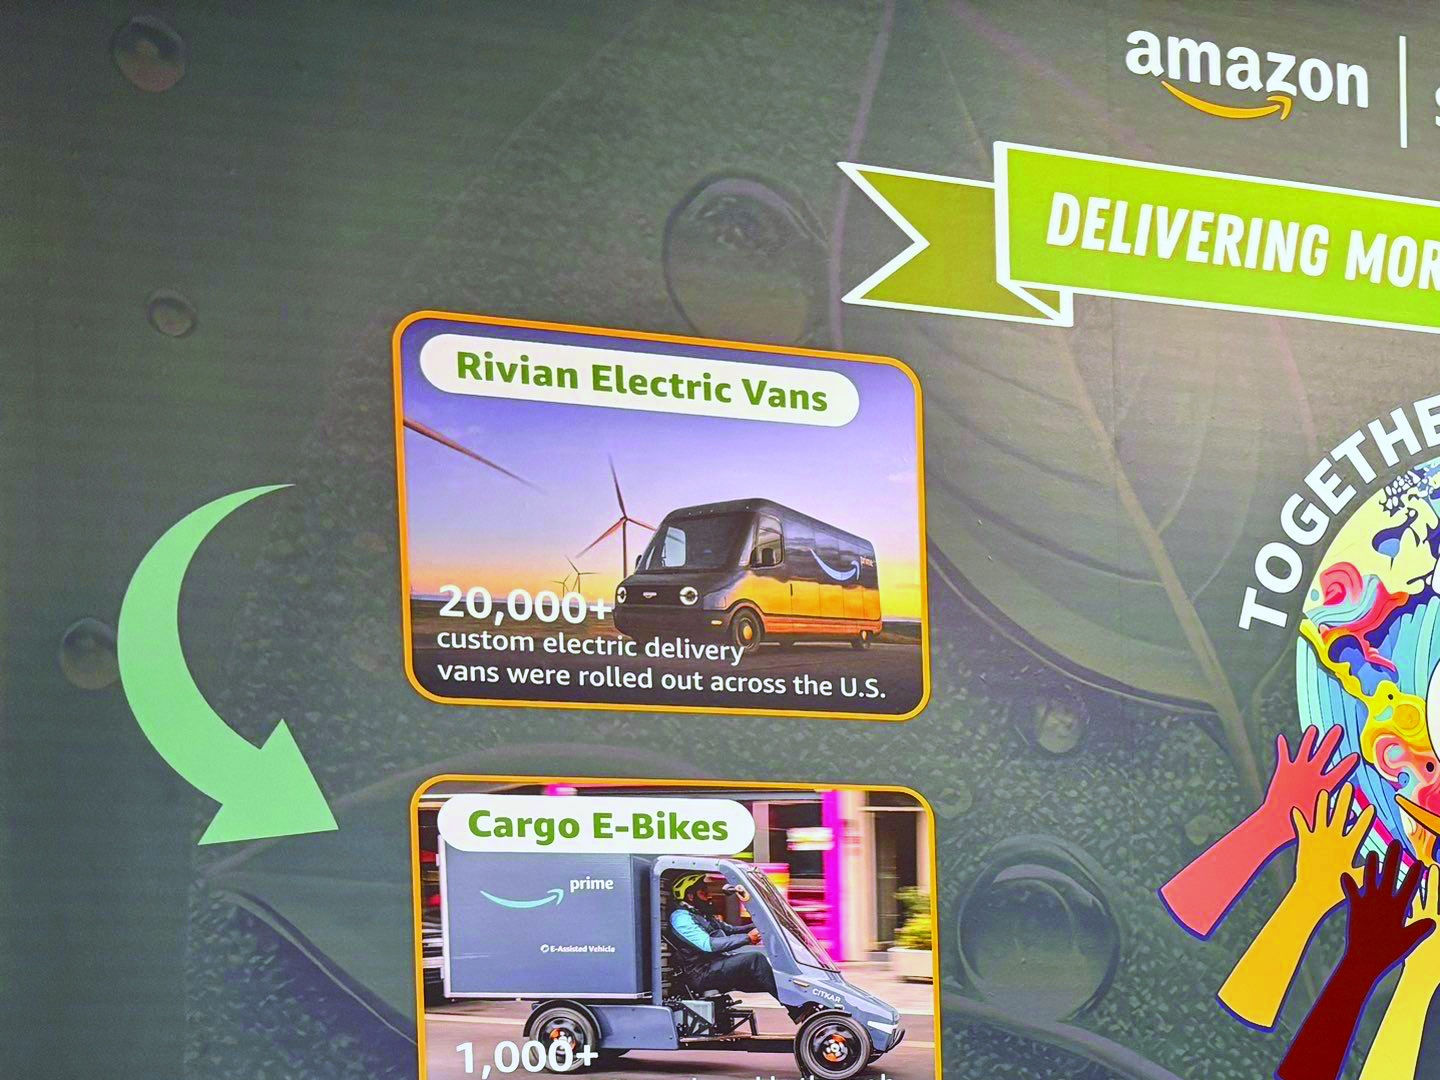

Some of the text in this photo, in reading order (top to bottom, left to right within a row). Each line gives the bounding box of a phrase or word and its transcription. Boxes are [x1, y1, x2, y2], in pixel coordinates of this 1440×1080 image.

[1125, 29, 1370, 108] amazon
[1046, 191, 1329, 278] DELIVERING
[457, 351, 828, 412] Rivian Electric Vans
[438, 584, 612, 625] 20,000+
[437, 629, 745, 666] custom electric delivery
[437, 662, 887, 699] vans were rolled out across the U.S.
[468, 810, 729, 845] Cargo E-Bikes
[570, 876, 614, 893] prime
[812, 988, 841, 1003] CITKAR
[455, 1040, 599, 1080] 1,000+
